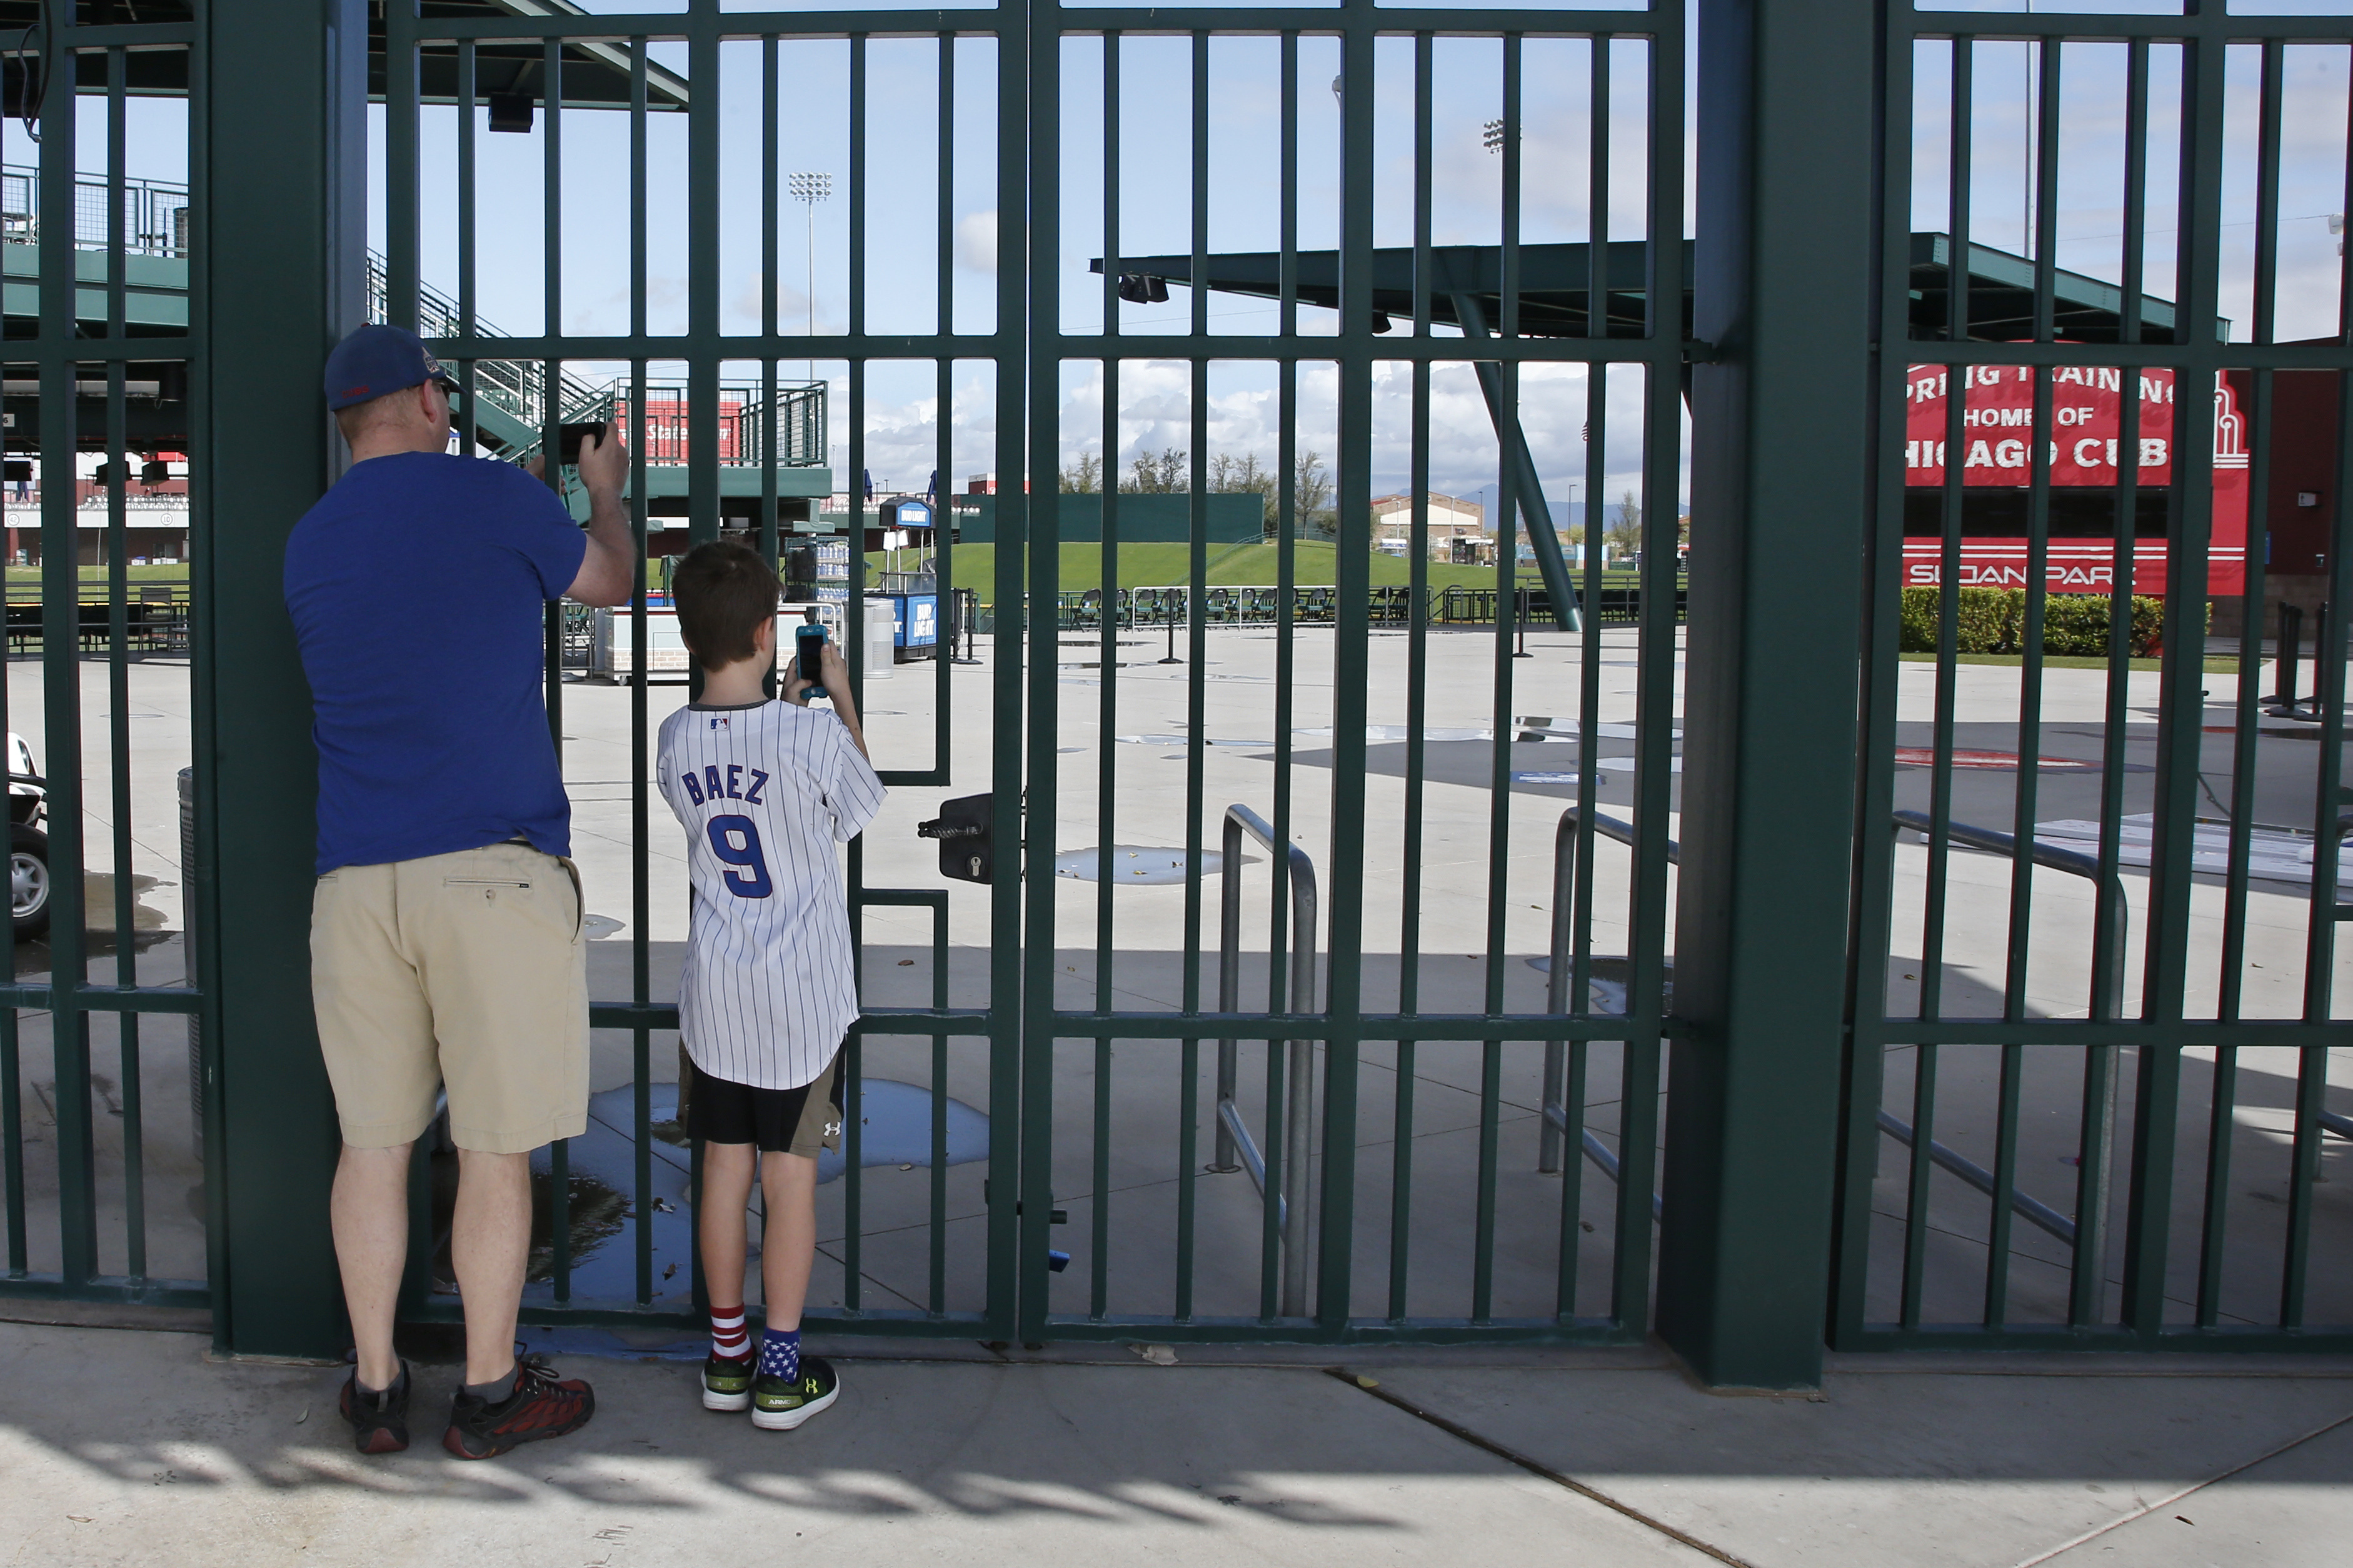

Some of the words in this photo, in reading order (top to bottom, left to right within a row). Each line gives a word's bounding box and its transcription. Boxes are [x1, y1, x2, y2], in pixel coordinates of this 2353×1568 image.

[2057, 407, 2094, 426] OF
[901, 509, 913, 522] BUD
[912, 510, 926, 522] LIGHT
[2045, 566, 2137, 586] PAR
[916, 604, 932, 621] BUD
[681, 764, 770, 807] BAEZ
[706, 814, 773, 899] 9
